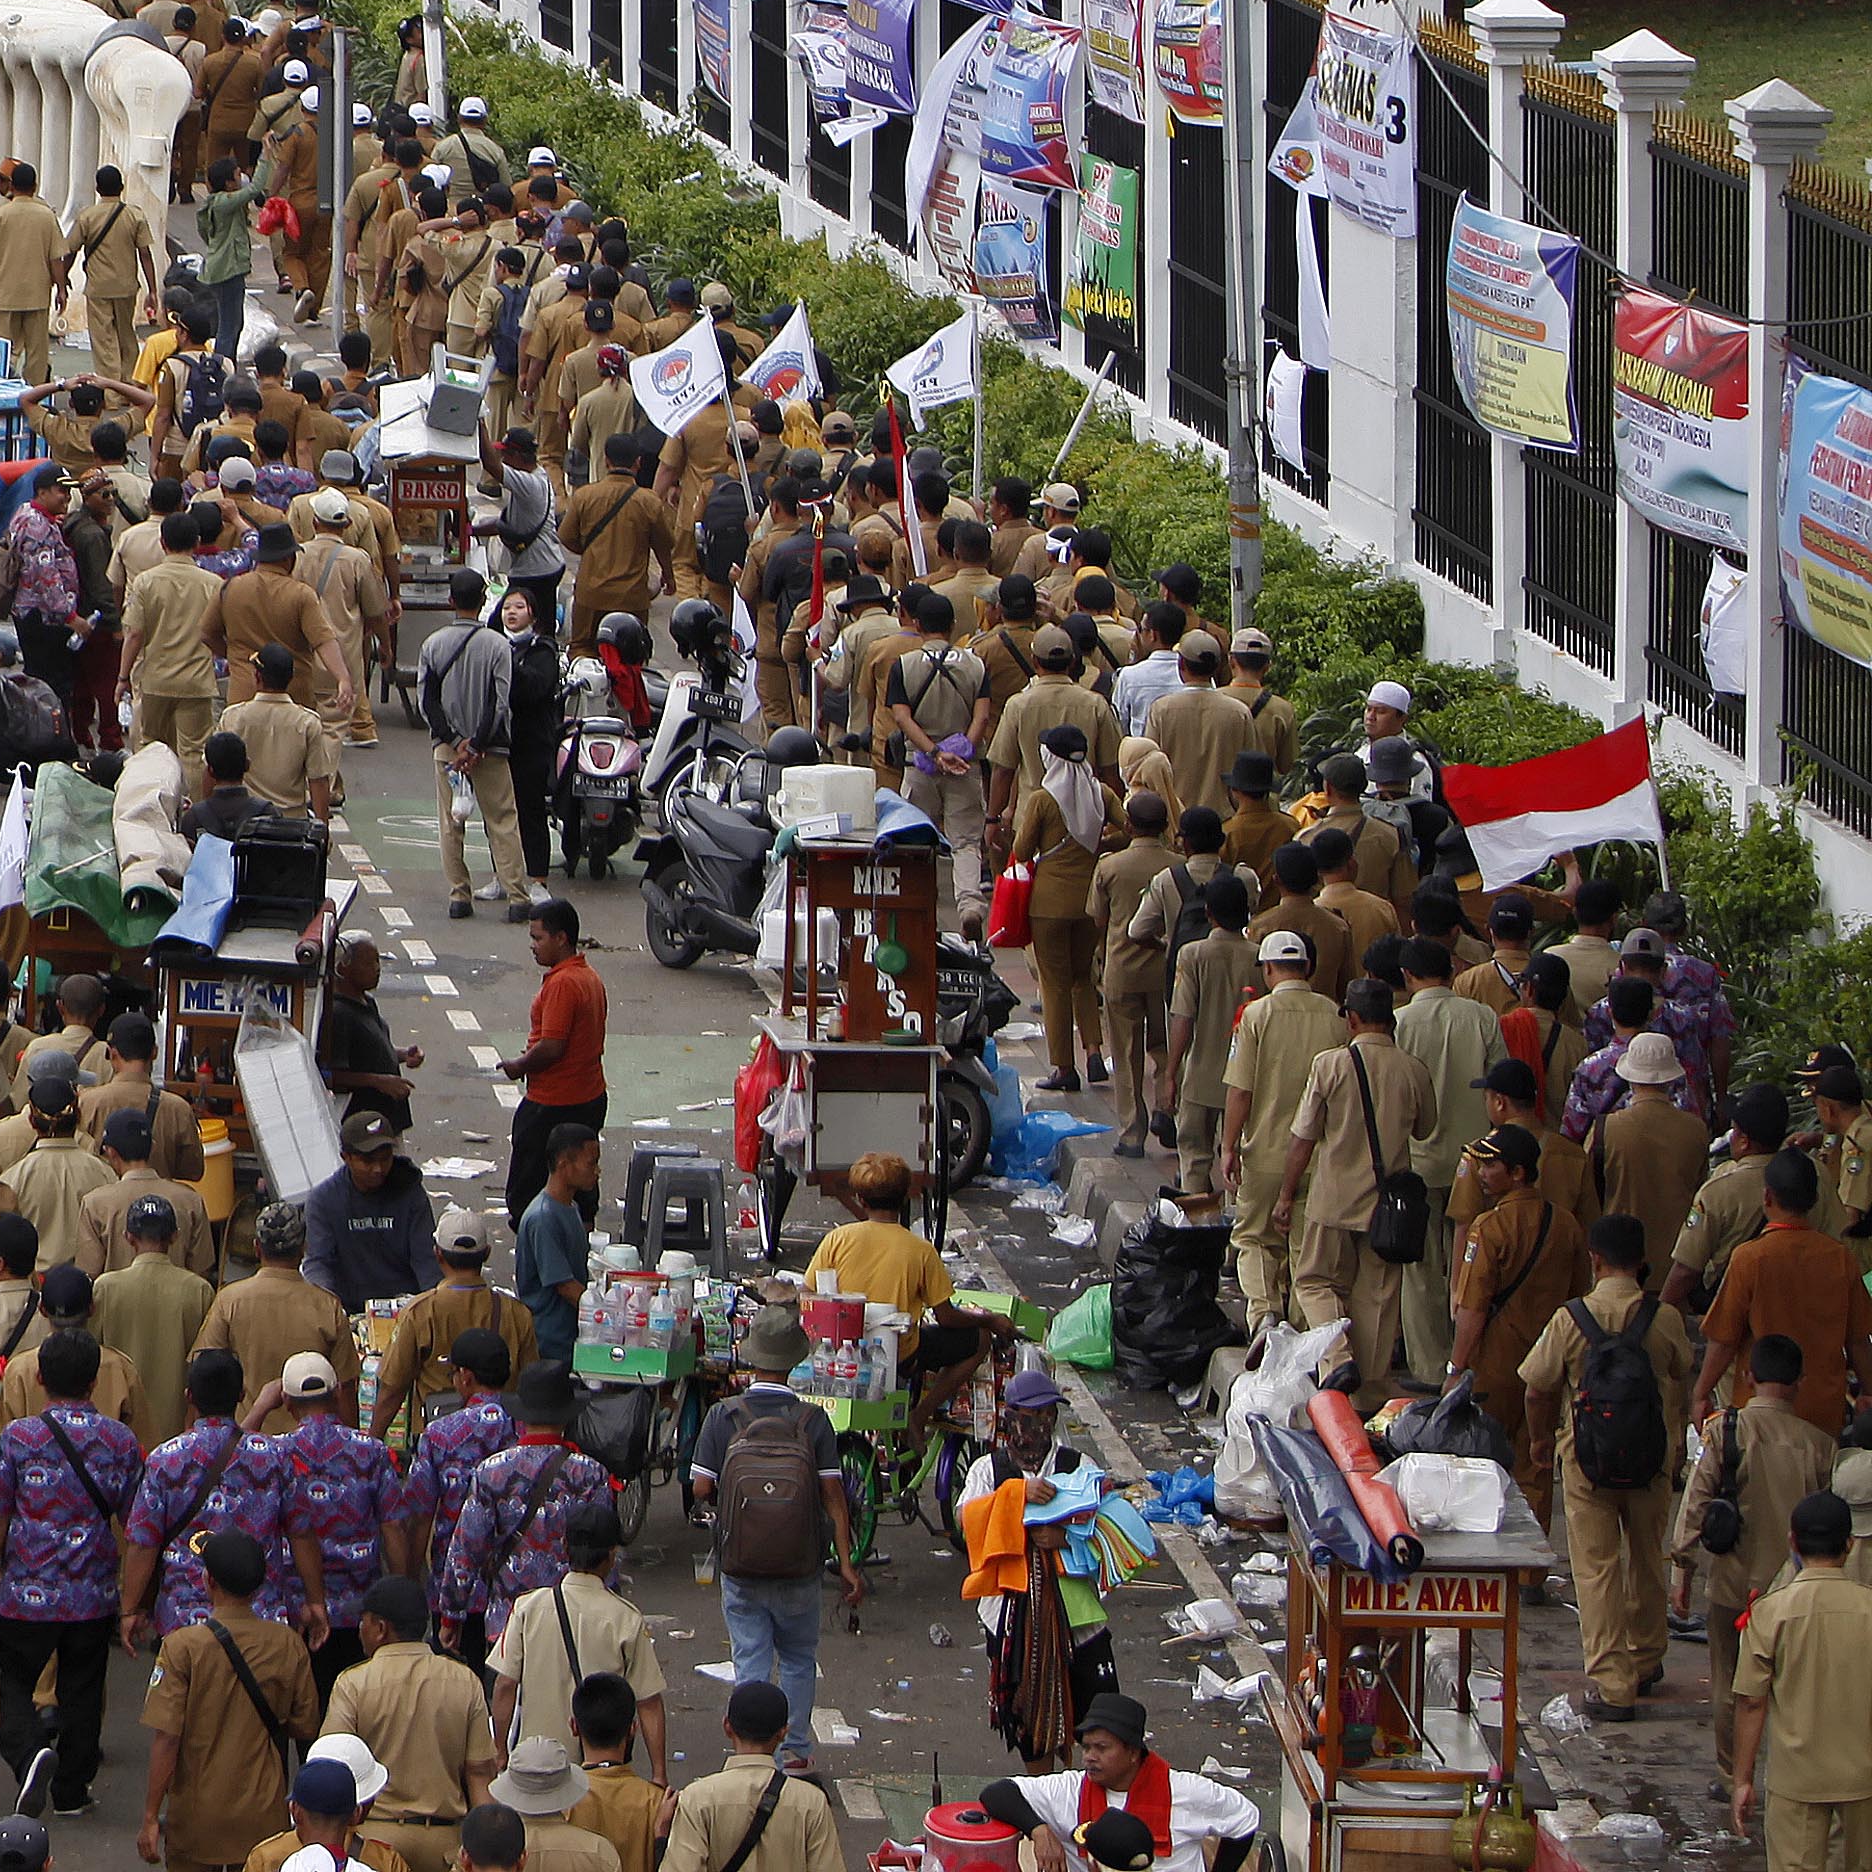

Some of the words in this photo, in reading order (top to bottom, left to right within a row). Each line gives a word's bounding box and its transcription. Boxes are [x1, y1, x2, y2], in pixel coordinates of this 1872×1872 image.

[1384, 94, 1407, 145] 3
[1660, 370, 1714, 422] NASIONAL
[401, 480, 460, 500] BAKSO
[853, 866, 901, 895] MIE
[184, 980, 225, 1010] MIE
[1346, 1576, 1409, 1611] MIE
[1416, 1576, 1500, 1613] AYAM
